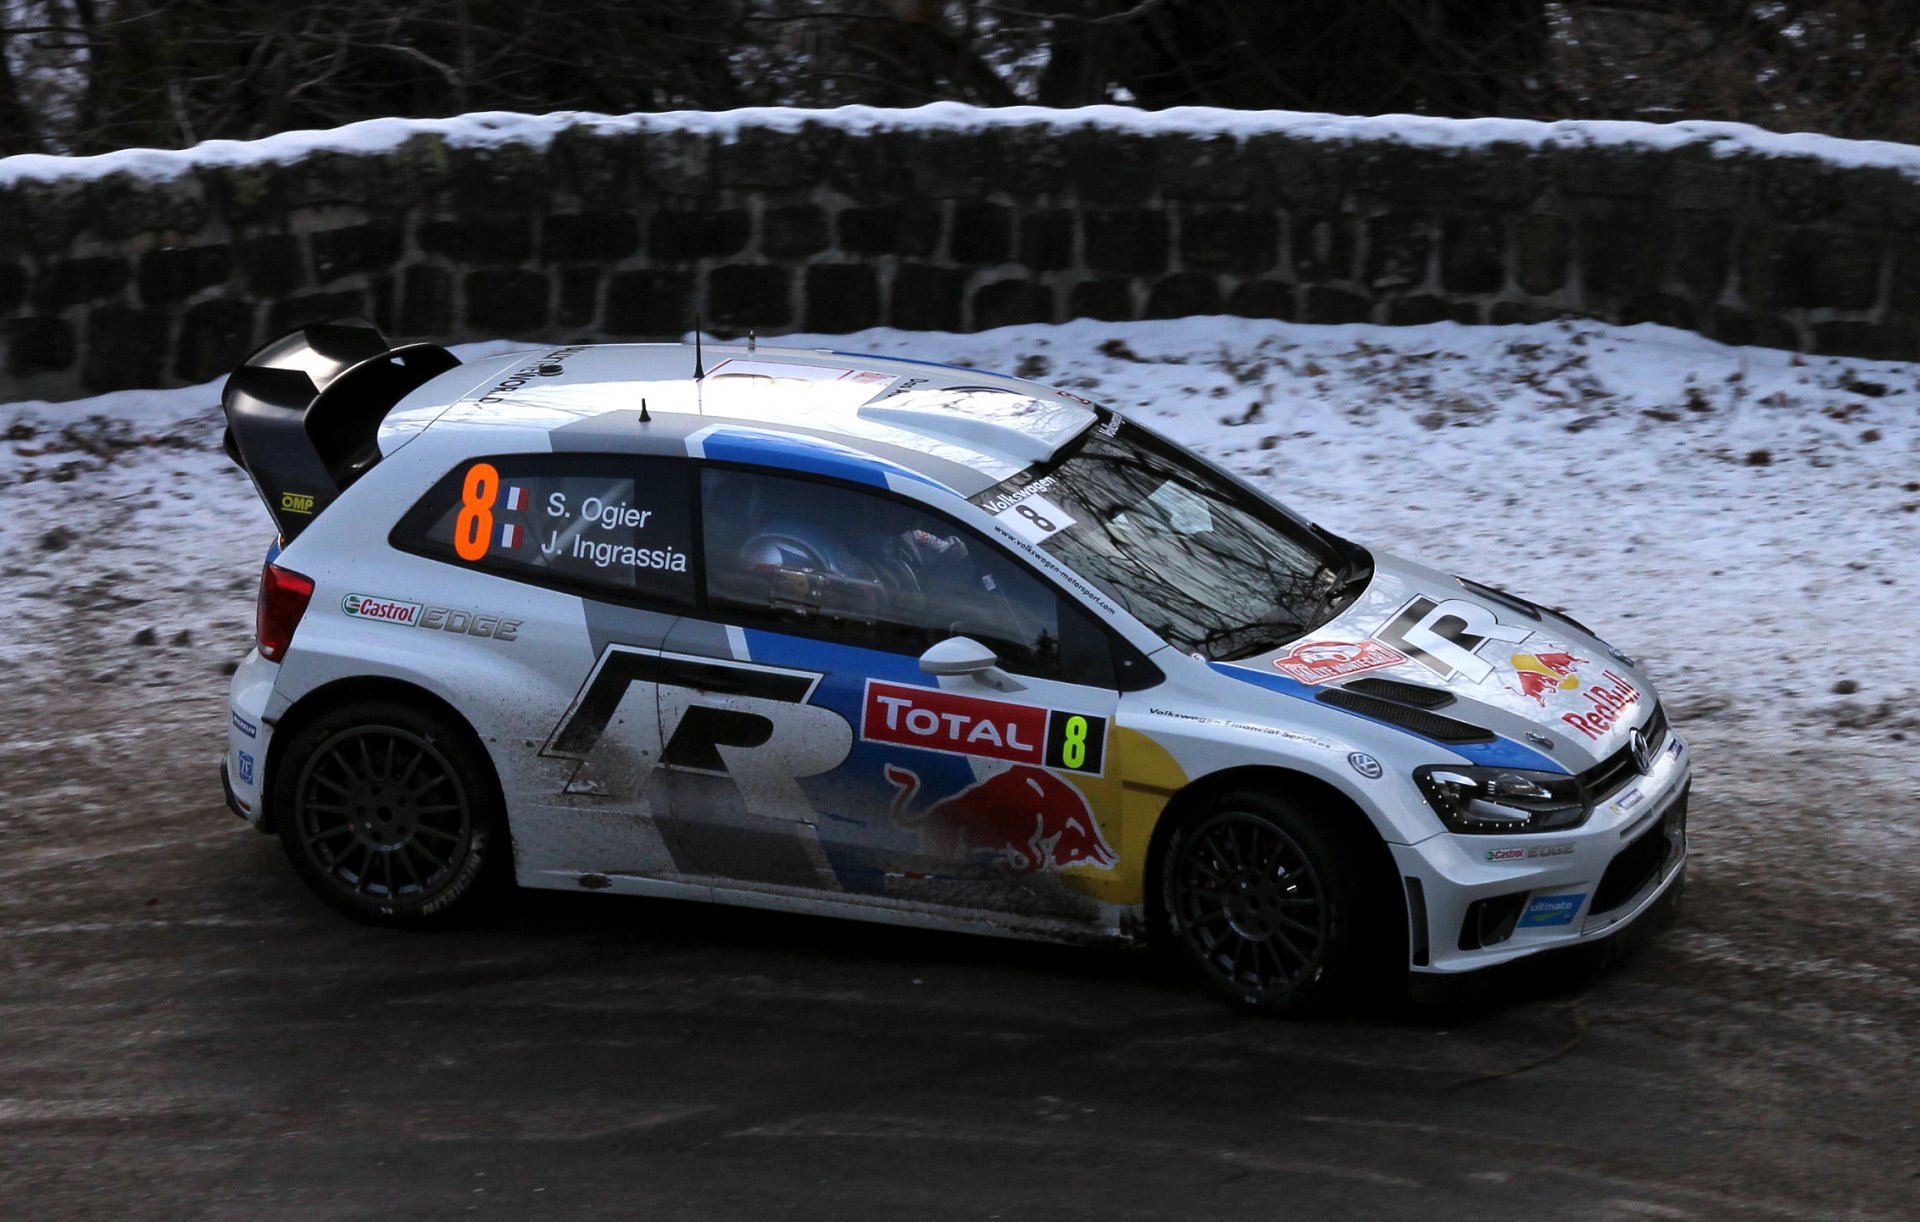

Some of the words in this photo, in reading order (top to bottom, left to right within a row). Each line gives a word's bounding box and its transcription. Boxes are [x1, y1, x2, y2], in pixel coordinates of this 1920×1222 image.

[282, 495, 314, 512] OMP
[454, 463, 499, 561] 8
[547, 493, 570, 518] S.
[581, 497, 652, 530] Ogier
[983, 476, 1057, 513] Volkswagen
[1015, 504, 1056, 532] 8
[541, 530, 562, 556] J.
[573, 534, 687, 573] Ingrassia
[994, 525, 1116, 615] www.volkswagen-motorsport.com
[360, 598, 417, 623] Castrol
[419, 606, 525, 643] EDGE
[876, 695, 1034, 752] TOTAL
[1149, 707, 1221, 726] Volkswagen
[1225, 719, 1280, 736] Financial
[1062, 715, 1088, 769] 8
[1530, 901, 1573, 912] ultimate
